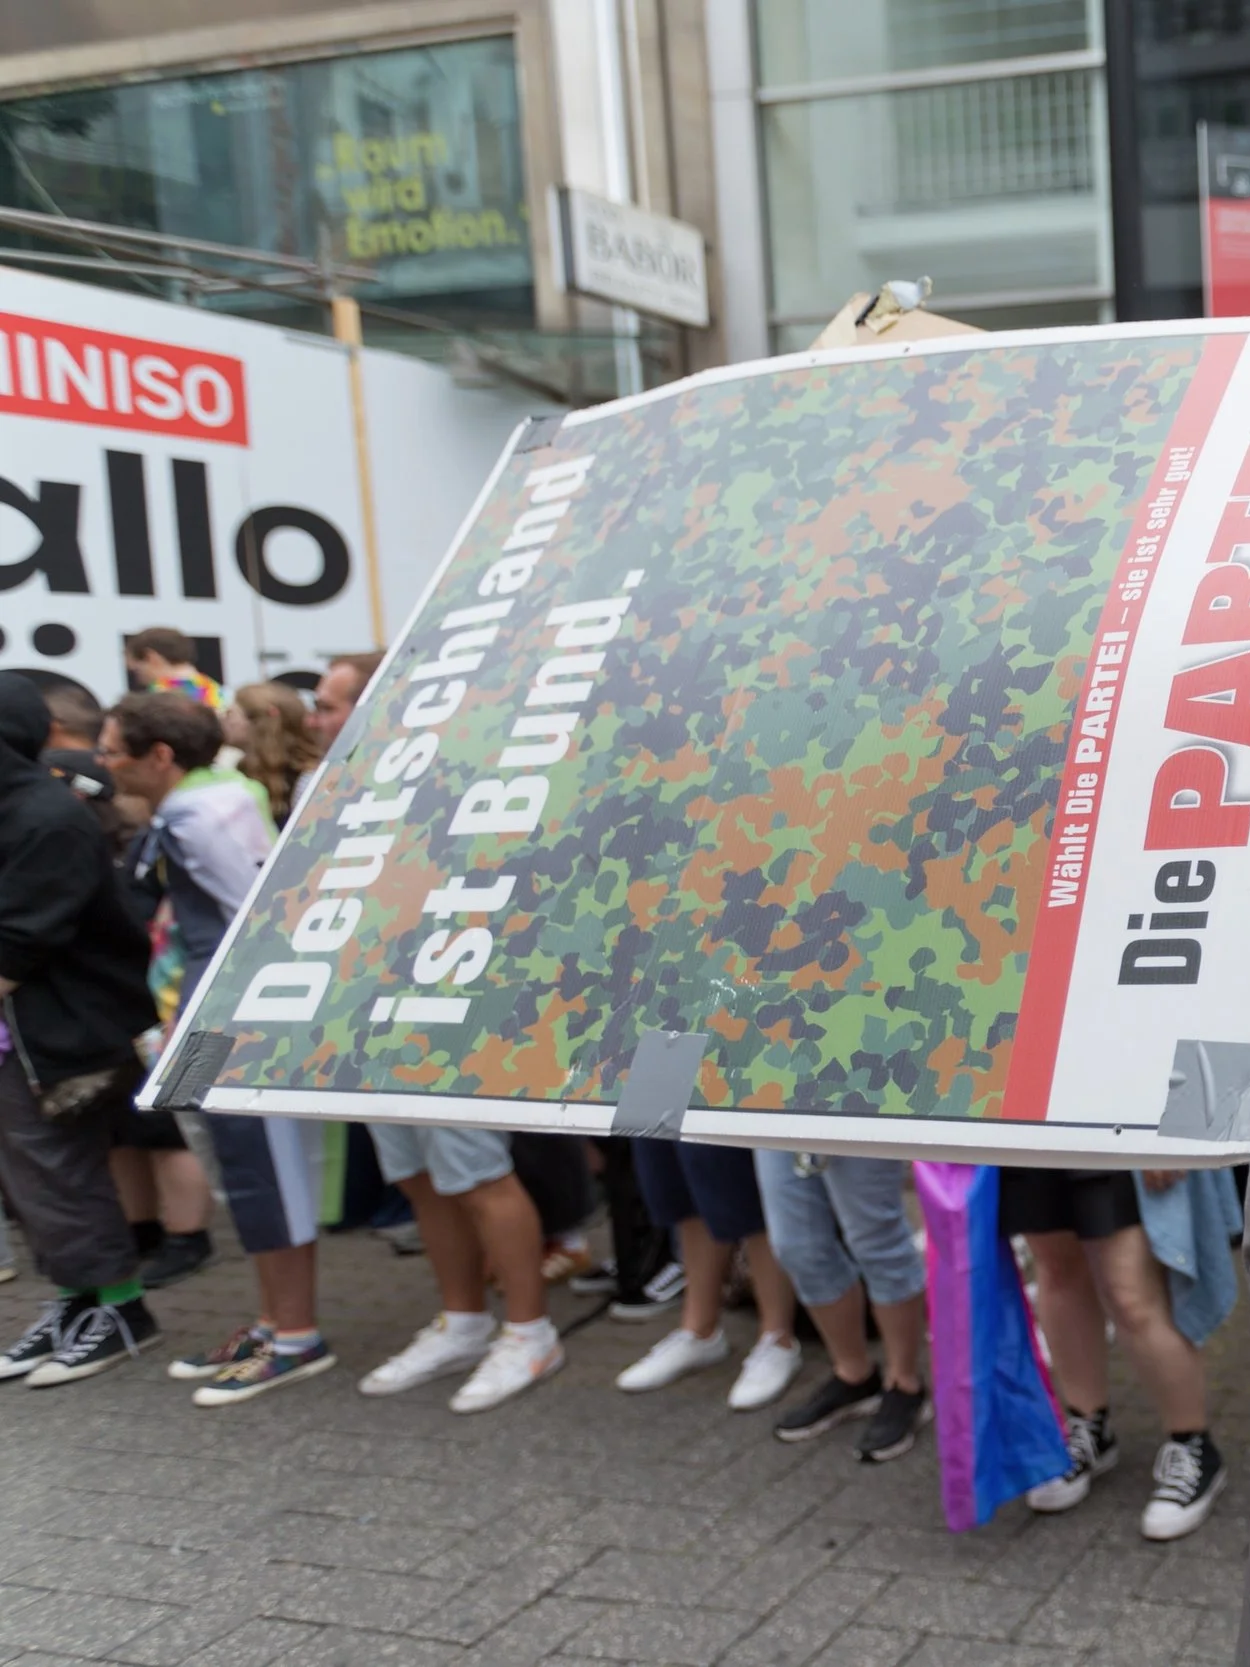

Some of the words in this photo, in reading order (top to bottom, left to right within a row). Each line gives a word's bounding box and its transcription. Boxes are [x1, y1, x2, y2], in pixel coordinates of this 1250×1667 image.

[1164, 446, 1196, 482] gut!
[1146, 487, 1178, 530] sehr
[1128, 535, 1161, 564] ist
[1119, 568, 1149, 602] sie
[1074, 630, 1130, 764] PARTEI
[232, 454, 596, 1022] Deutschland
[368, 874, 517, 1024] ist
[447, 568, 645, 836] Bund.
[1065, 773, 1099, 815] Die
[1047, 823, 1090, 908] Wählt
[1116, 859, 1216, 986] Die
